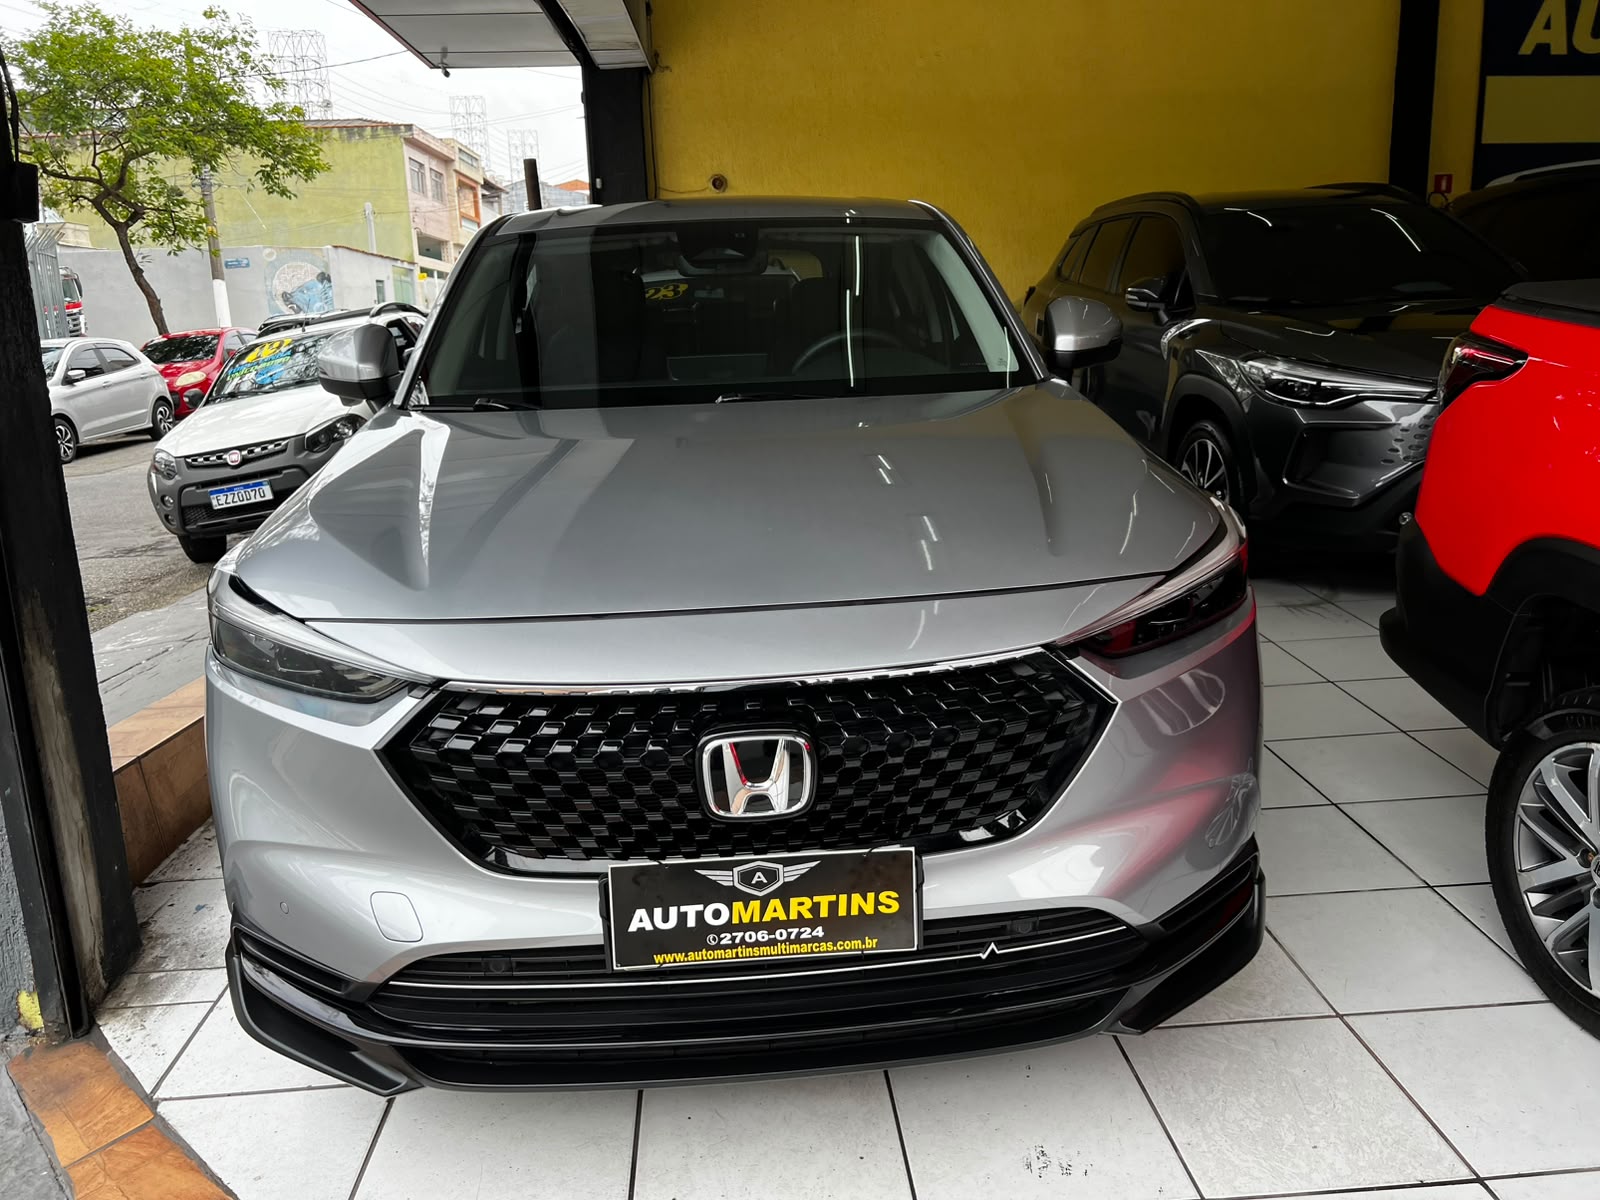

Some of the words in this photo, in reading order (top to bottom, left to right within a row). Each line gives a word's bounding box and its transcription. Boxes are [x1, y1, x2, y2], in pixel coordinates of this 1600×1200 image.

[751, 871, 768, 884] A
[628, 891, 900, 932] AUTOMARTINS
[719, 926, 825, 946] 2706-0724
[653, 936, 879, 965] www.automartinsmultimarcas.com.br
